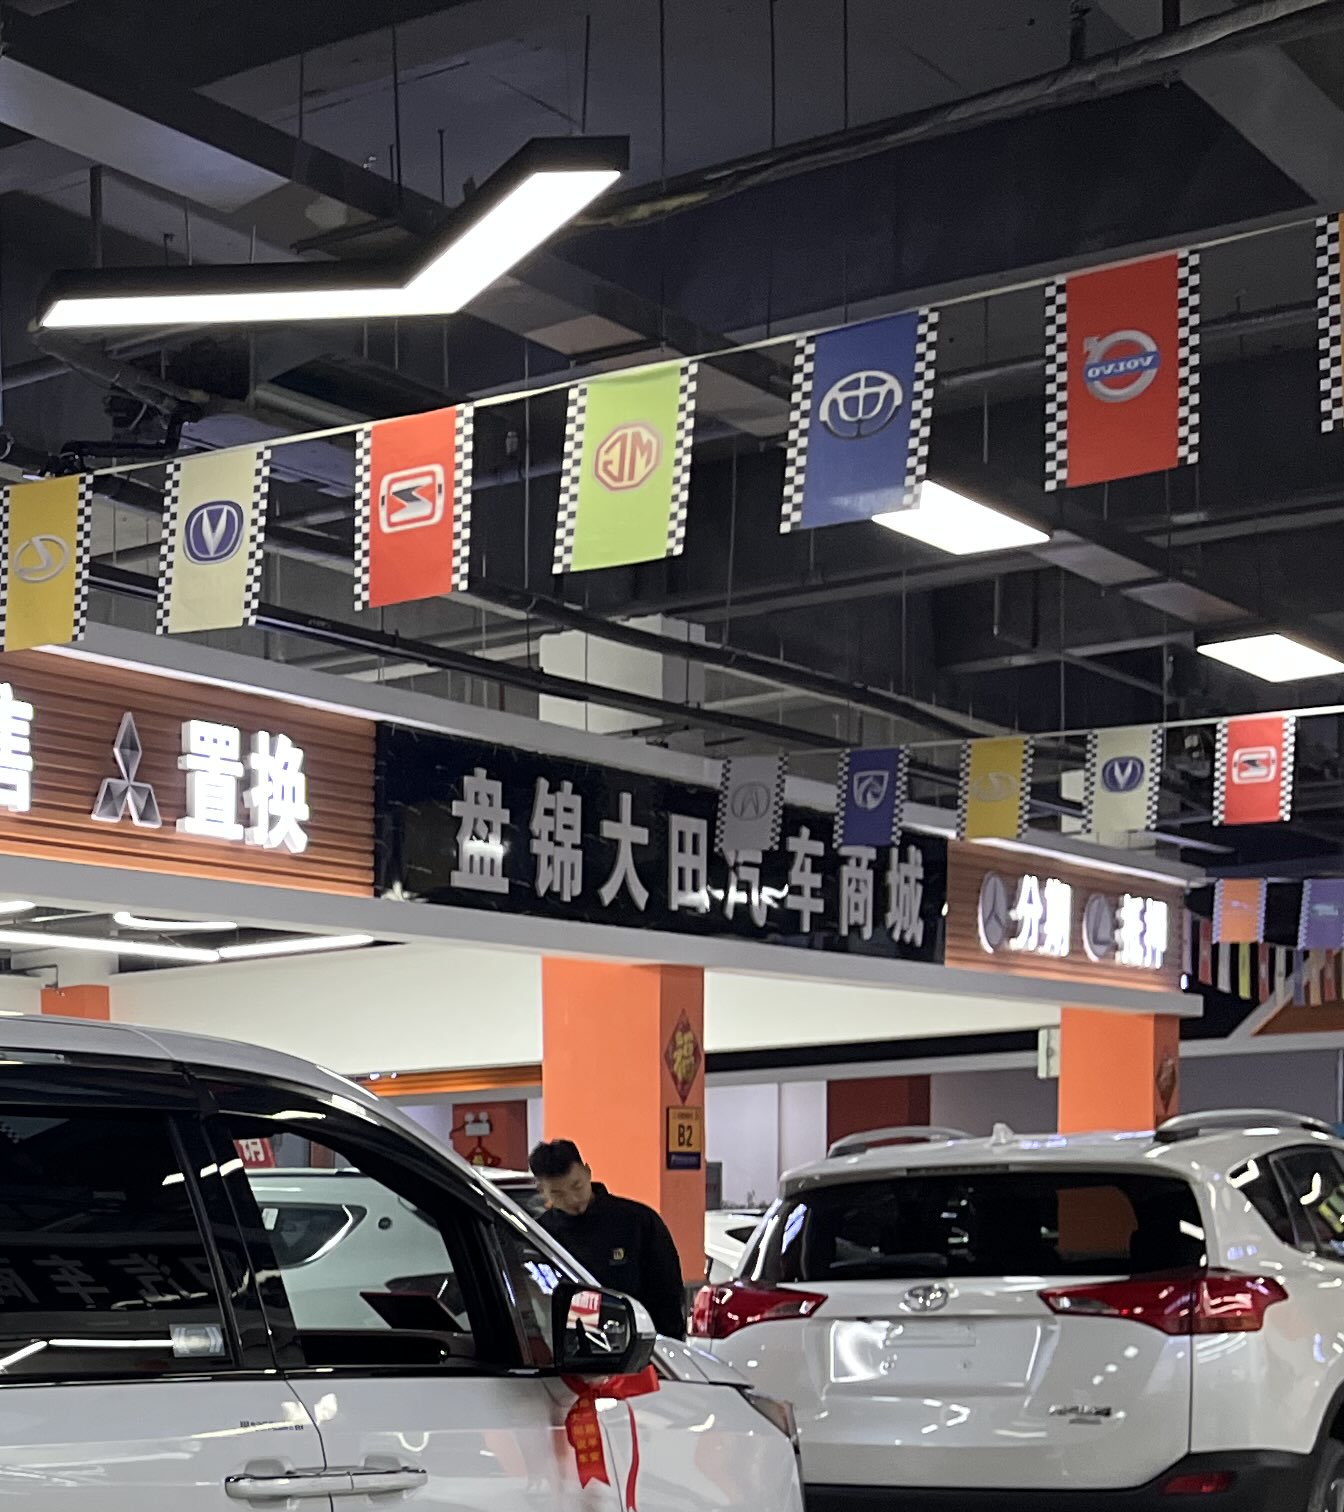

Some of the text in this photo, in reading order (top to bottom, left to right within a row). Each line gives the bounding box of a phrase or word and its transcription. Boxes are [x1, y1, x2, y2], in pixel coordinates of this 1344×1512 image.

[176, 719, 310, 854] 置换
[450, 766, 924, 948] 盘锦大田汽车商城
[677, 1124, 694, 1148] B2
